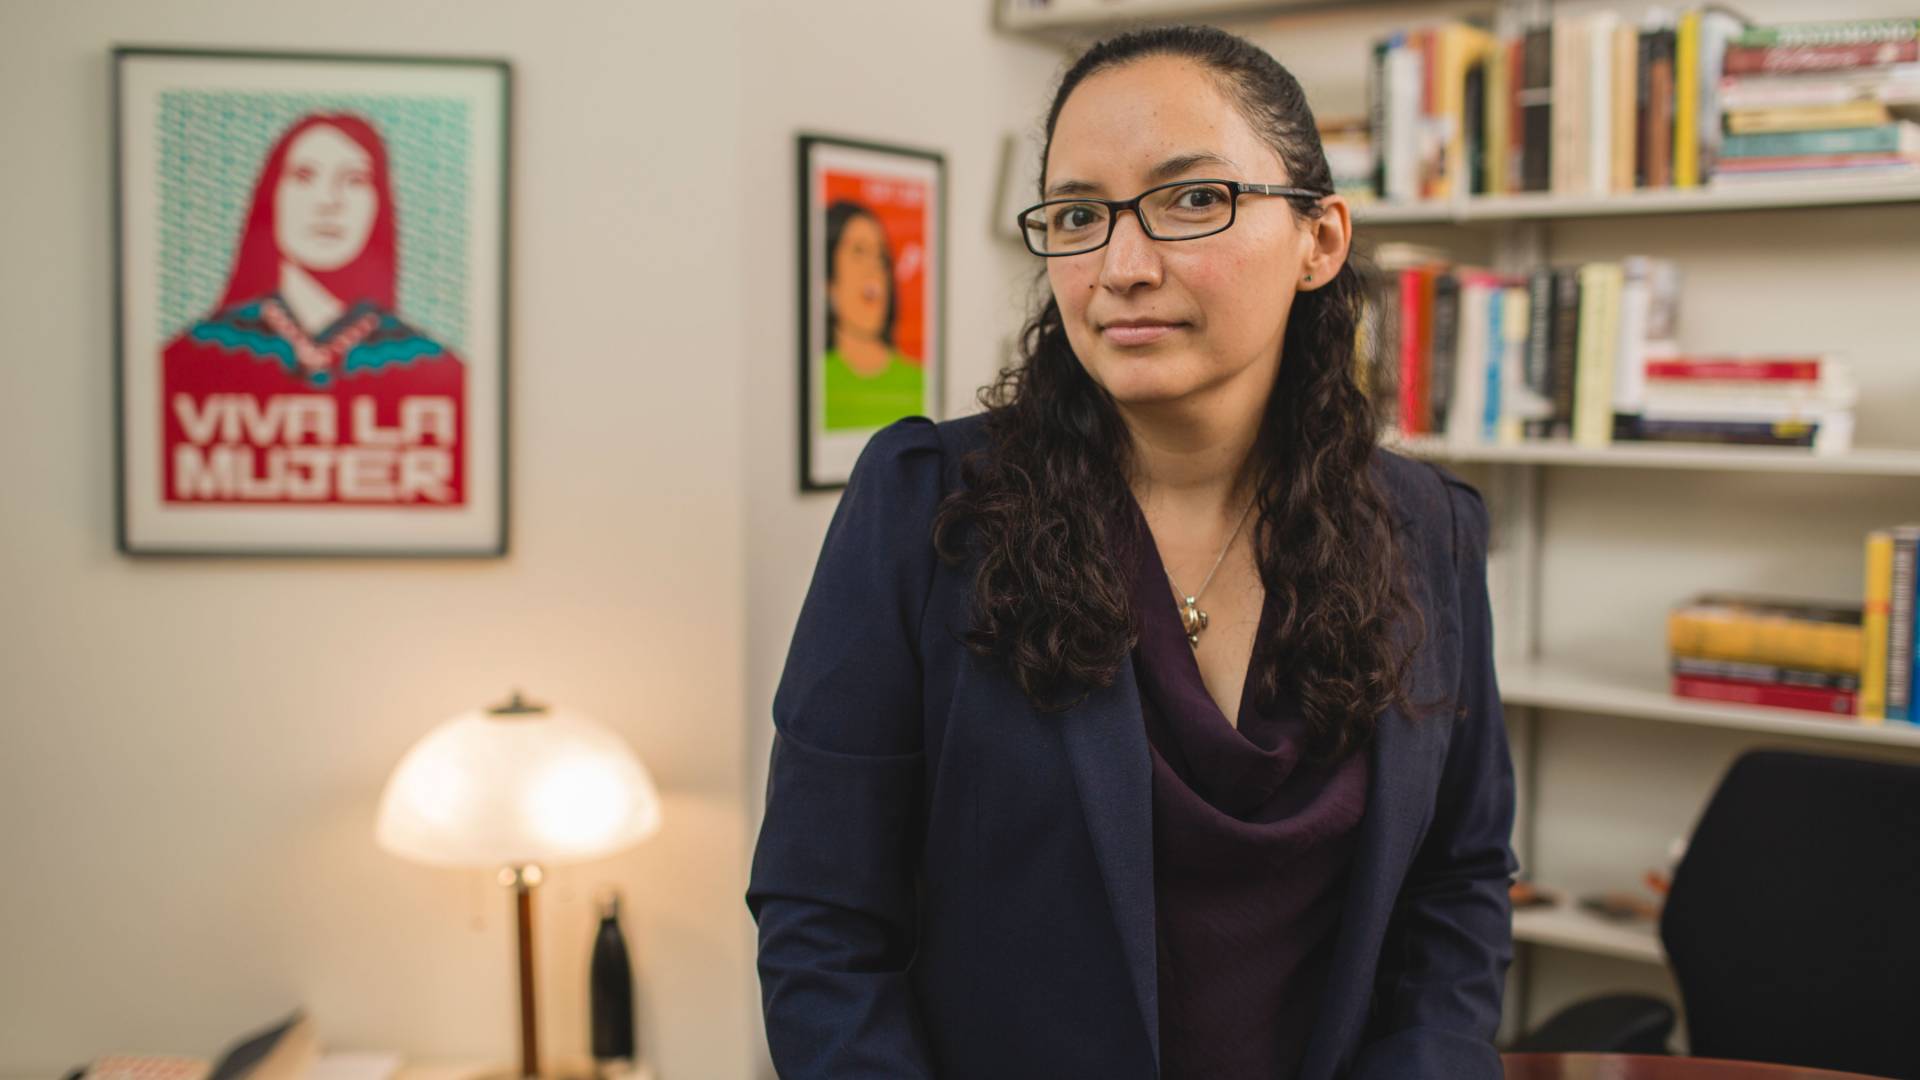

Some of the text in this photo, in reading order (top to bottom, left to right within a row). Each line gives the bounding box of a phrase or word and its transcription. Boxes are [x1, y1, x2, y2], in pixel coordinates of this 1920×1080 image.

[174, 394, 455, 443] VIVA LA
[175, 444, 453, 502] MUJER
